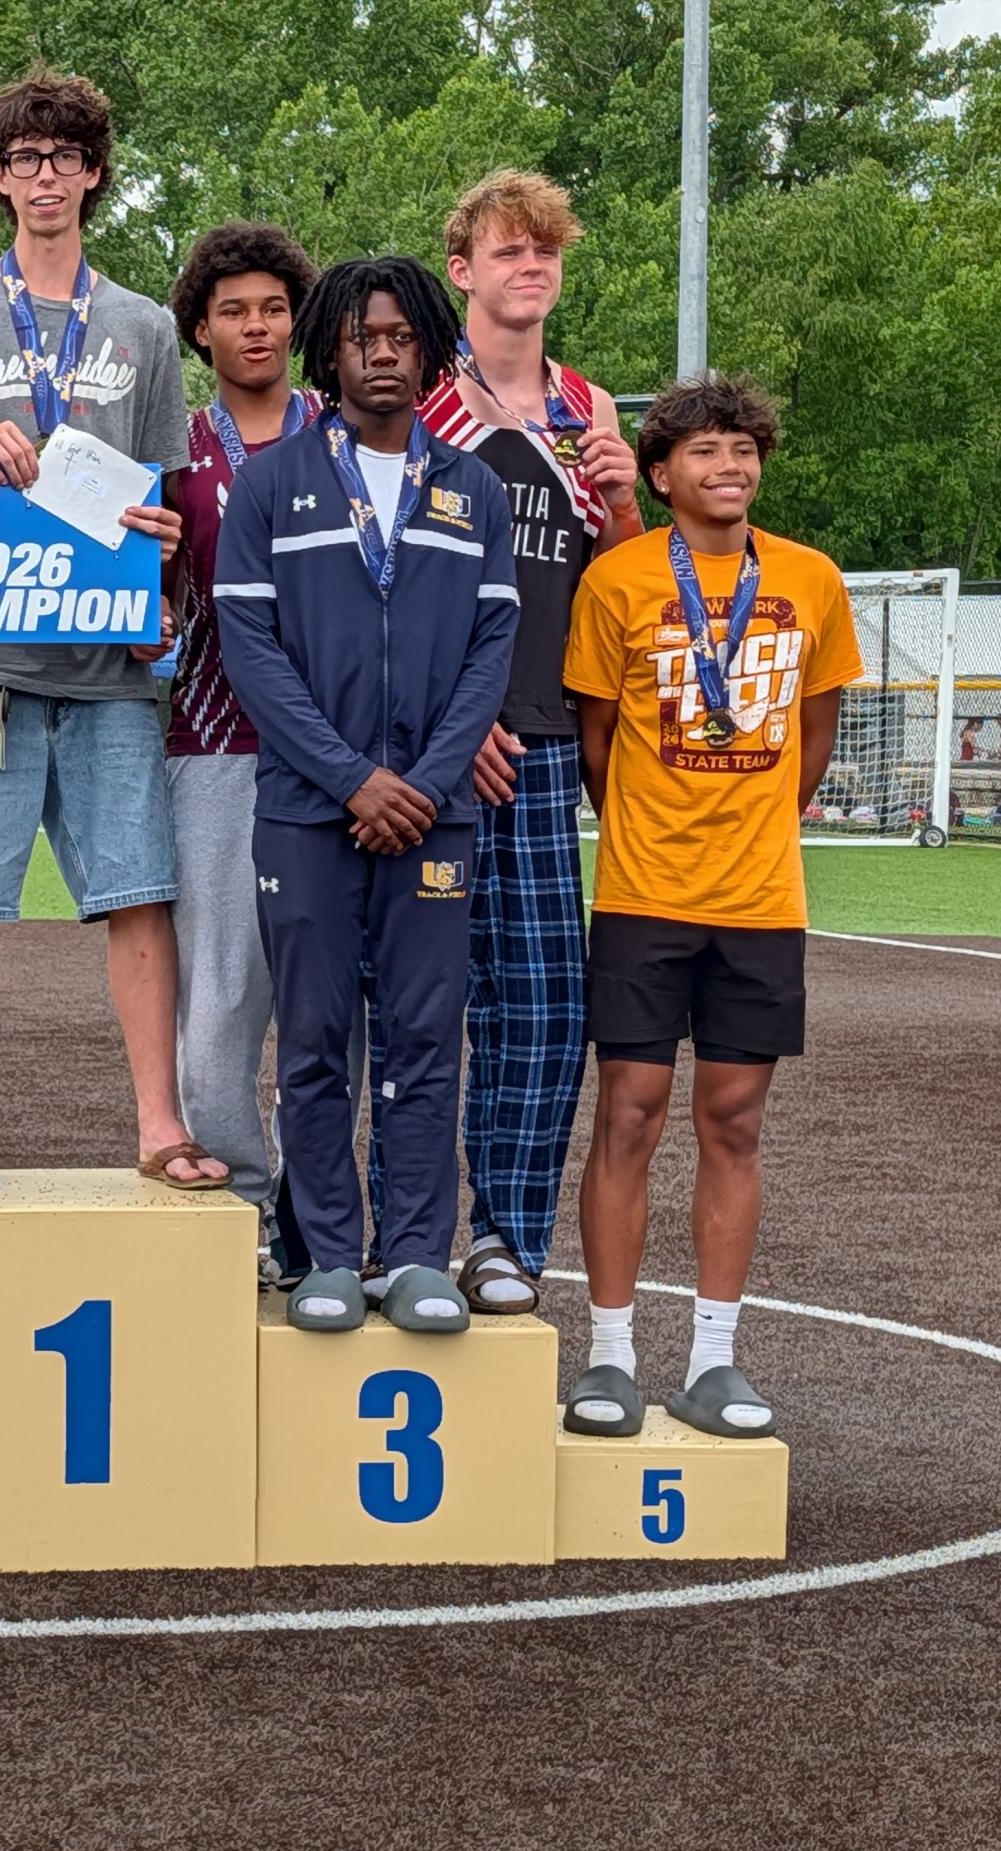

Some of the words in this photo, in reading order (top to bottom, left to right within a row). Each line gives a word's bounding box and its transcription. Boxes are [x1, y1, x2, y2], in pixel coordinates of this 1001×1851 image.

[215, 412, 249, 471] NYSPHS
[502, 482, 550, 520] TIA
[510, 520, 570, 563] ILLE
[730, 600, 780, 615] RK
[679, 668, 799, 723] FELD
[675, 753, 728, 768] STATE
[732, 754, 770, 769] TEAM
[34, 1300, 111, 1484] 1
[358, 1369, 444, 1523] 3
[641, 1469, 686, 1544] 5
